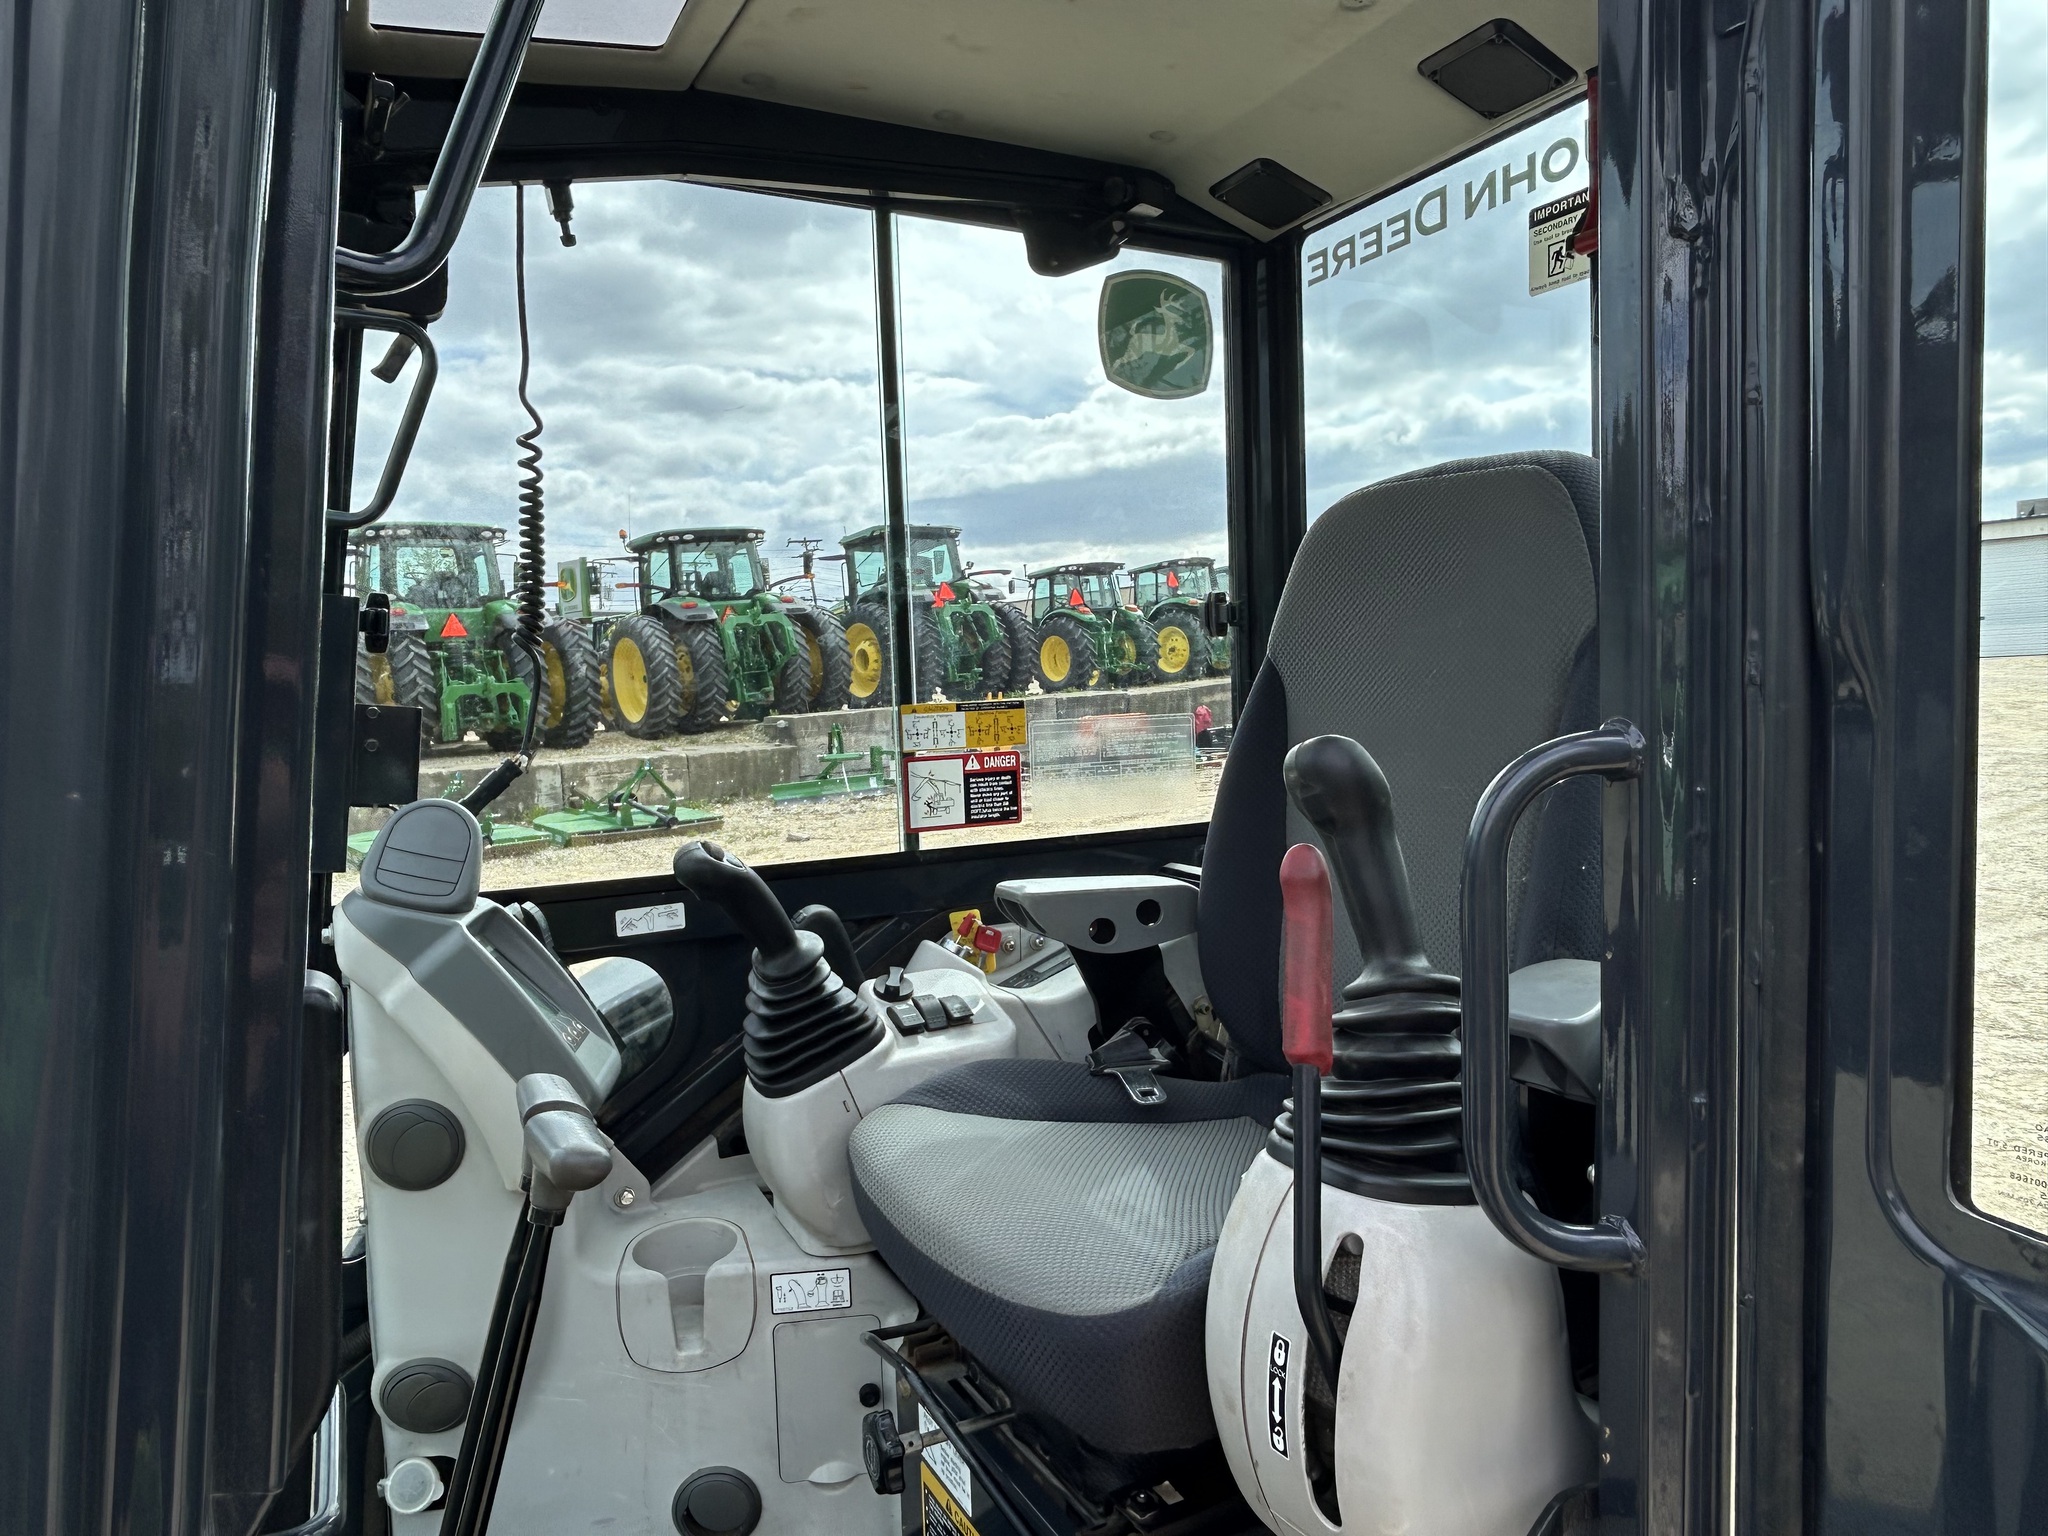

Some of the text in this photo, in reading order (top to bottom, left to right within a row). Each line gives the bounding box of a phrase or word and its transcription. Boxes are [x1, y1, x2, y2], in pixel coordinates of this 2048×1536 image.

[1533, 214, 1578, 238] SECONDARY
[984, 755, 1016, 768] DANGER
[1270, 1364, 1286, 1379] LOCK
